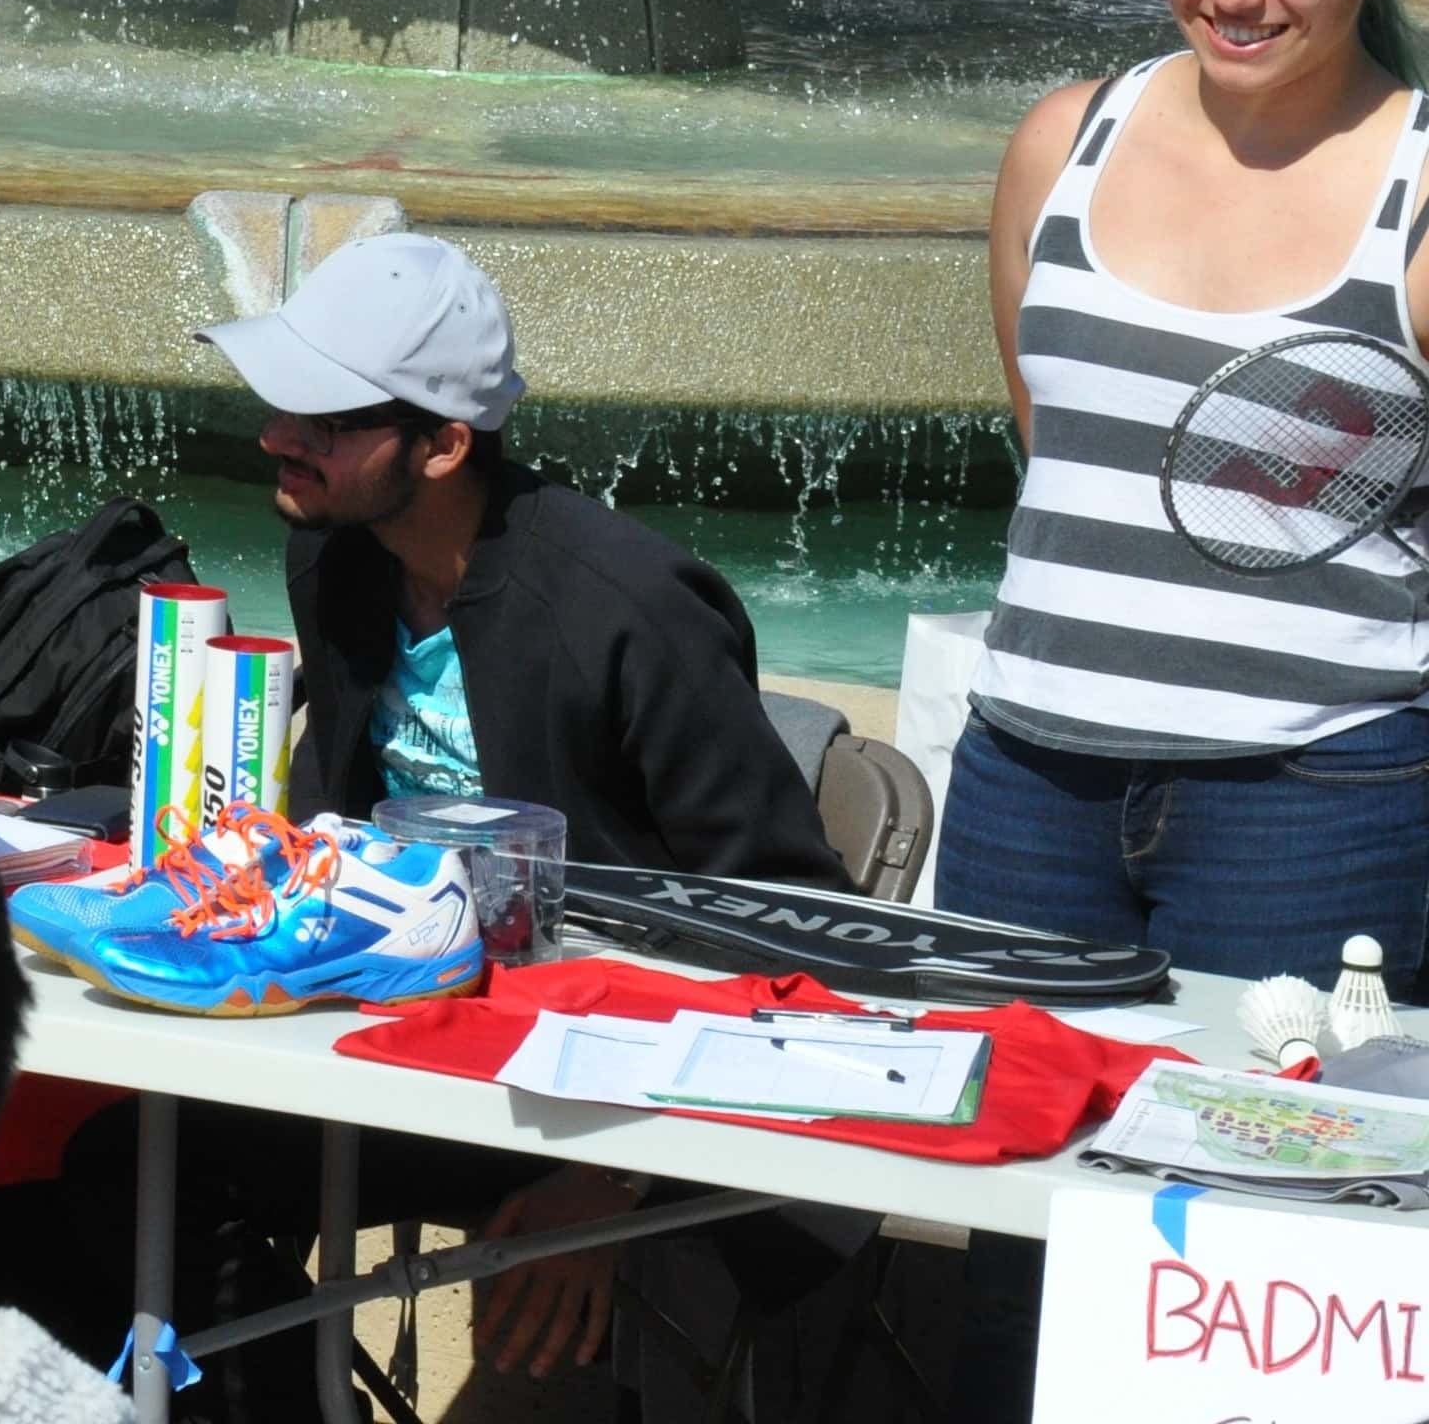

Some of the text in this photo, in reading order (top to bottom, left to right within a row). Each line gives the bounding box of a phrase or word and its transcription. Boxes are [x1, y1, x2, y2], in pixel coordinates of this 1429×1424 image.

[151, 639, 173, 706] YONEX
[237, 696, 260, 767] YONEX
[646, 879, 936, 952] YONEX
[1147, 1260, 1425, 1383] BADMI
